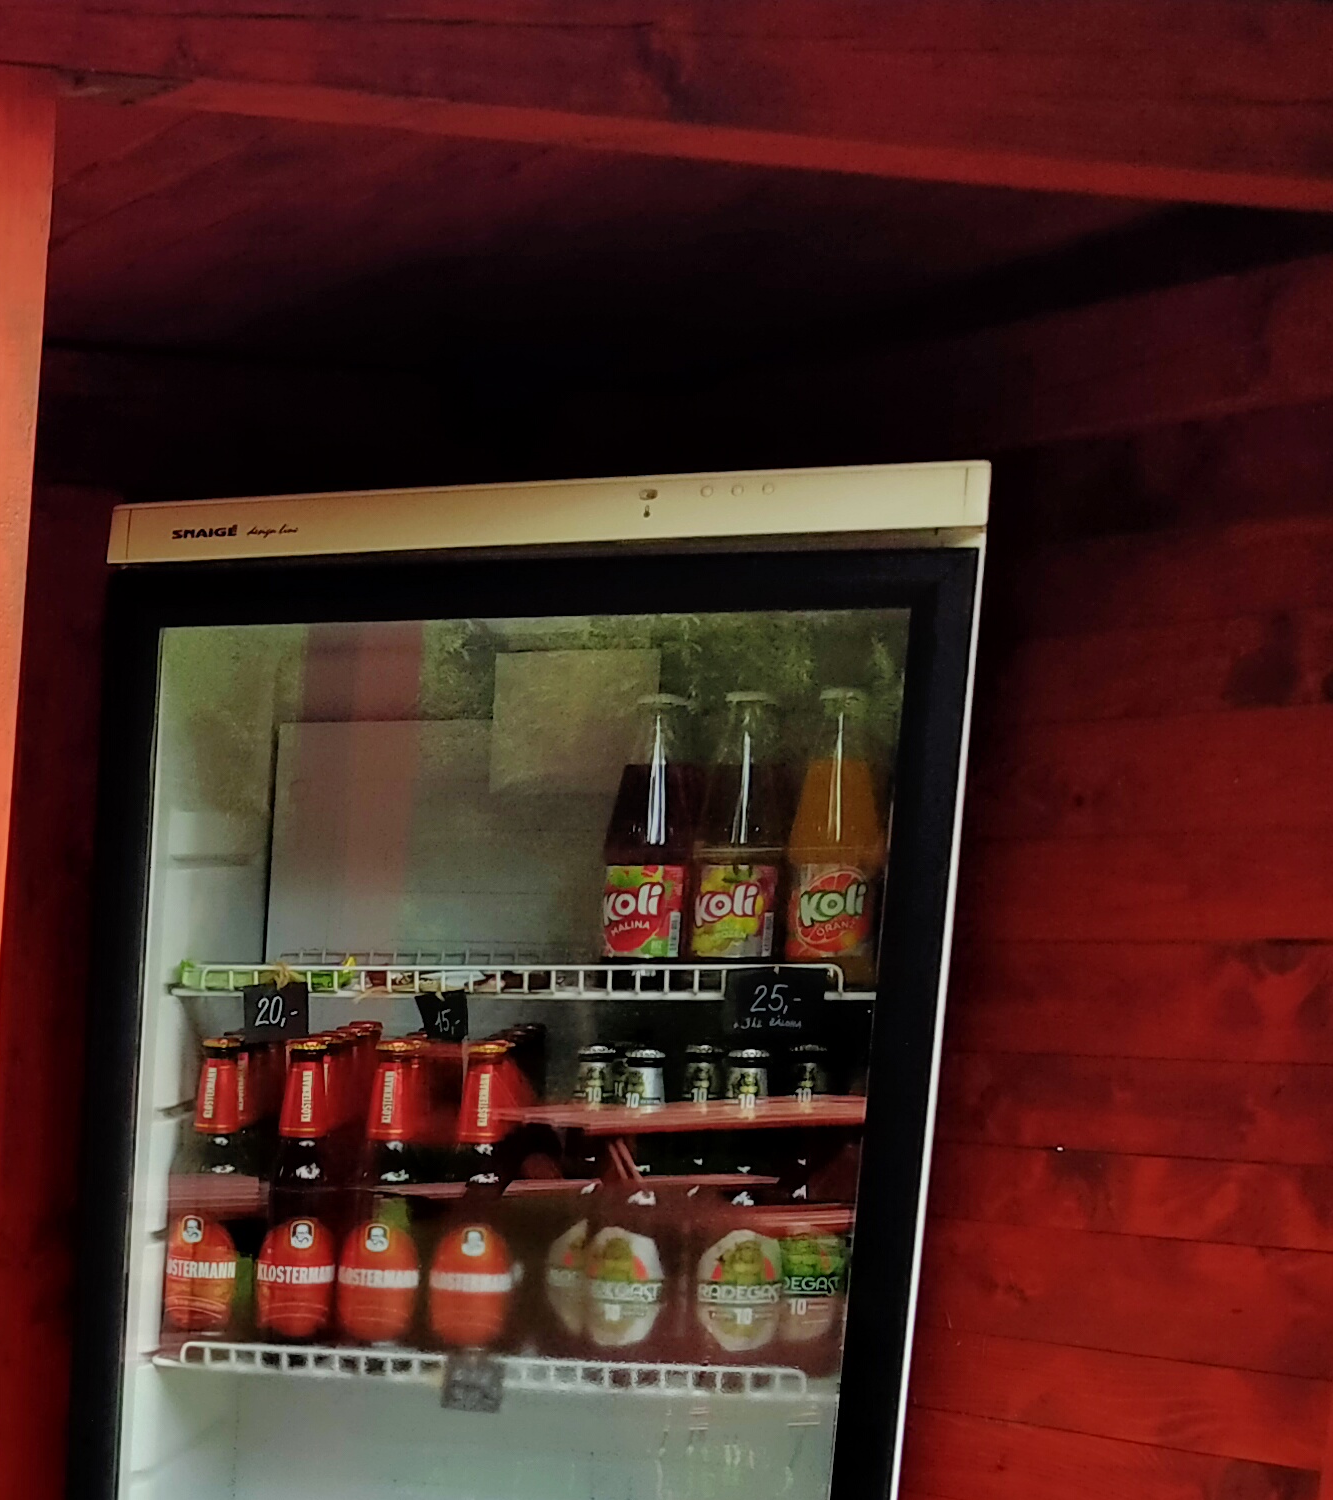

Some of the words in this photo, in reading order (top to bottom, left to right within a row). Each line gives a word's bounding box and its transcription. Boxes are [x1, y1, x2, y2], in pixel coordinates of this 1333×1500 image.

[611, 920, 650, 937] MALINA
[255, 996, 298, 1027] 20,-
[750, 984, 801, 1014] 25,-
[435, 1009, 460, 1035] 15,-
[625, 1092, 639, 1108] 10
